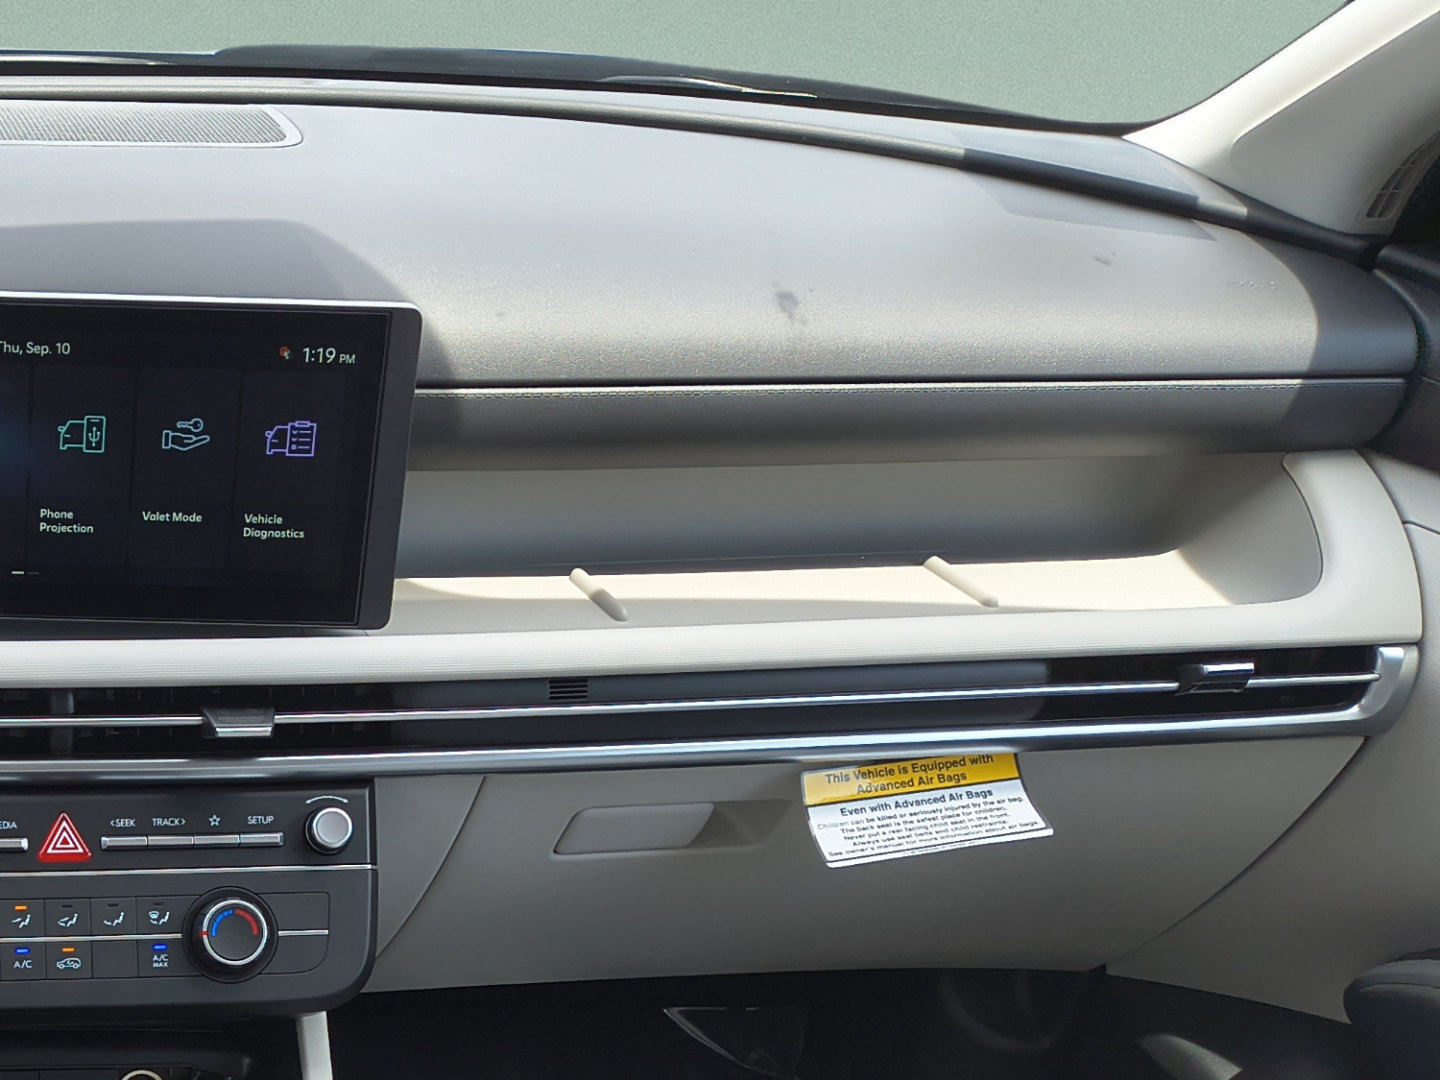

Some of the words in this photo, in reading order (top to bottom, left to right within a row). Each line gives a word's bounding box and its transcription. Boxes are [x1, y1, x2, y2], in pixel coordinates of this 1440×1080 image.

[26, 342, 52, 357] Sep.
[55, 343, 71, 355] 10
[302, 347, 336, 364] 1:19
[339, 353, 356, 365] PM
[40, 509, 74, 520] Phone
[142, 511, 170, 523] Valet
[172, 512, 202, 523] Mode
[244, 514, 283, 525] Vehicle
[39, 522, 94, 535] Projection
[243, 528, 305, 541] Diagnostics
[825, 773, 850, 784] This
[853, 767, 895, 780] Vehicle
[898, 765, 908, 775] is
[912, 757, 967, 774] Equipped
[969, 754, 994, 766] with
[857, 778, 914, 794] Advanced
[918, 776, 934, 786] Air
[937, 772, 967, 784] Bags
[840, 807, 867, 817] Even
[869, 802, 892, 812] with
[894, 794, 946, 809] Advanced
[948, 792, 963, 802] Air
[966, 788, 994, 800] Bags
[247, 815, 274, 825] SETUP
[153, 953, 168, 962] A/C
[14, 959, 33, 969] A/C
[153, 961, 169, 969] MAX
